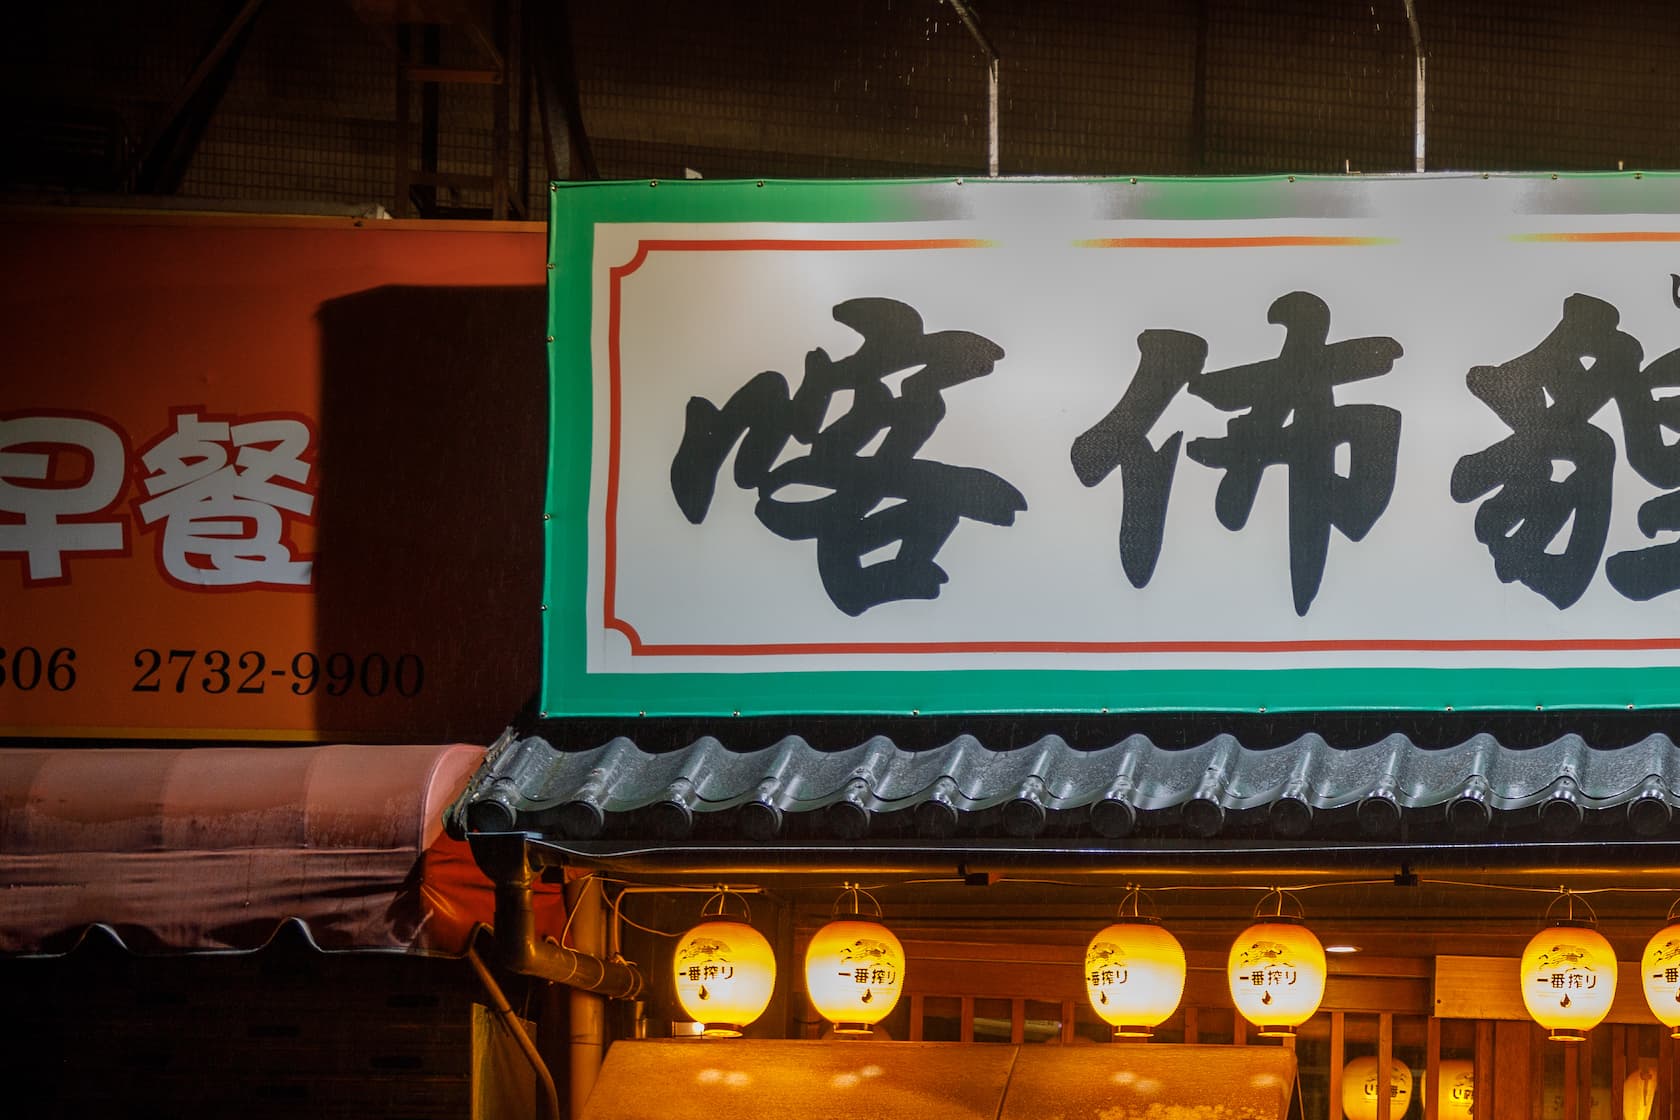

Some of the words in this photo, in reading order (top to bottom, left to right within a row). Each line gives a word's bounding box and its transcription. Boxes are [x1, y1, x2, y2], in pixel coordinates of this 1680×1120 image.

[0, 412, 315, 586] 早餐
[0, 646, 77, 692] 06
[131, 649, 426, 698] 2732-9900
[678, 966, 734, 982] 一番搾り
[837, 968, 897, 985] 一番搾り
[1239, 970, 1297, 986] 一番搾り
[1536, 973, 1598, 989] 一番搾り
